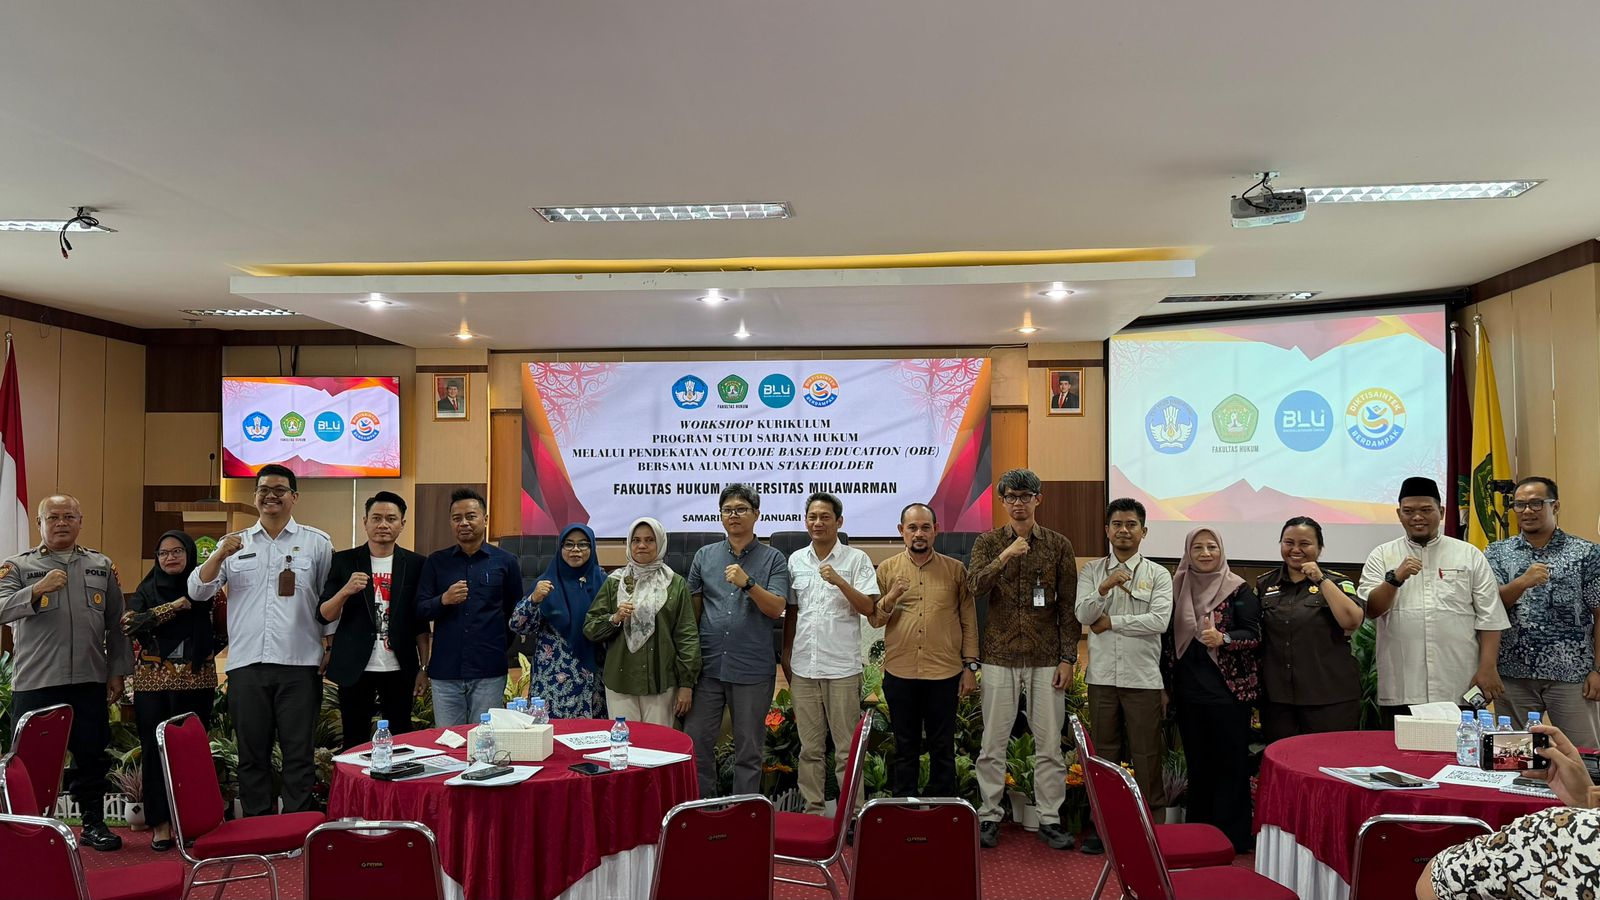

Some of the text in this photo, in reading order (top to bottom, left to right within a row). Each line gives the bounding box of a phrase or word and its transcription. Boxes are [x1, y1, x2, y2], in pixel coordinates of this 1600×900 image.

[764, 383, 791, 396] BLU
[1349, 390, 1402, 412] DIKTISAINTEK
[680, 419, 831, 429] WORKSHOP KURIKULUM
[1282, 409, 1325, 428] BLU
[317, 420, 341, 431] BLU
[652, 433, 859, 444] PROGRAM STUDI SARJANA HUKUM
[1350, 429, 1400, 448] BERDAMPAK
[572, 446, 940, 458] MELALUI PENDEKATAN OUTCOME BASED EDUCATION (OBE)
[1211, 445, 1259, 454] FAKULTAS HUKUM
[637, 460, 874, 471] BERSAMA ALUMNI DAN STAKEHOLDER
[613, 482, 672, 495] FAKULTAS
[676, 482, 721, 495] HUKUM
[809, 482, 897, 495] MULAWARMAN
[759, 513, 802, 522] JANUARI
[85, 568, 107, 577] POLRI
